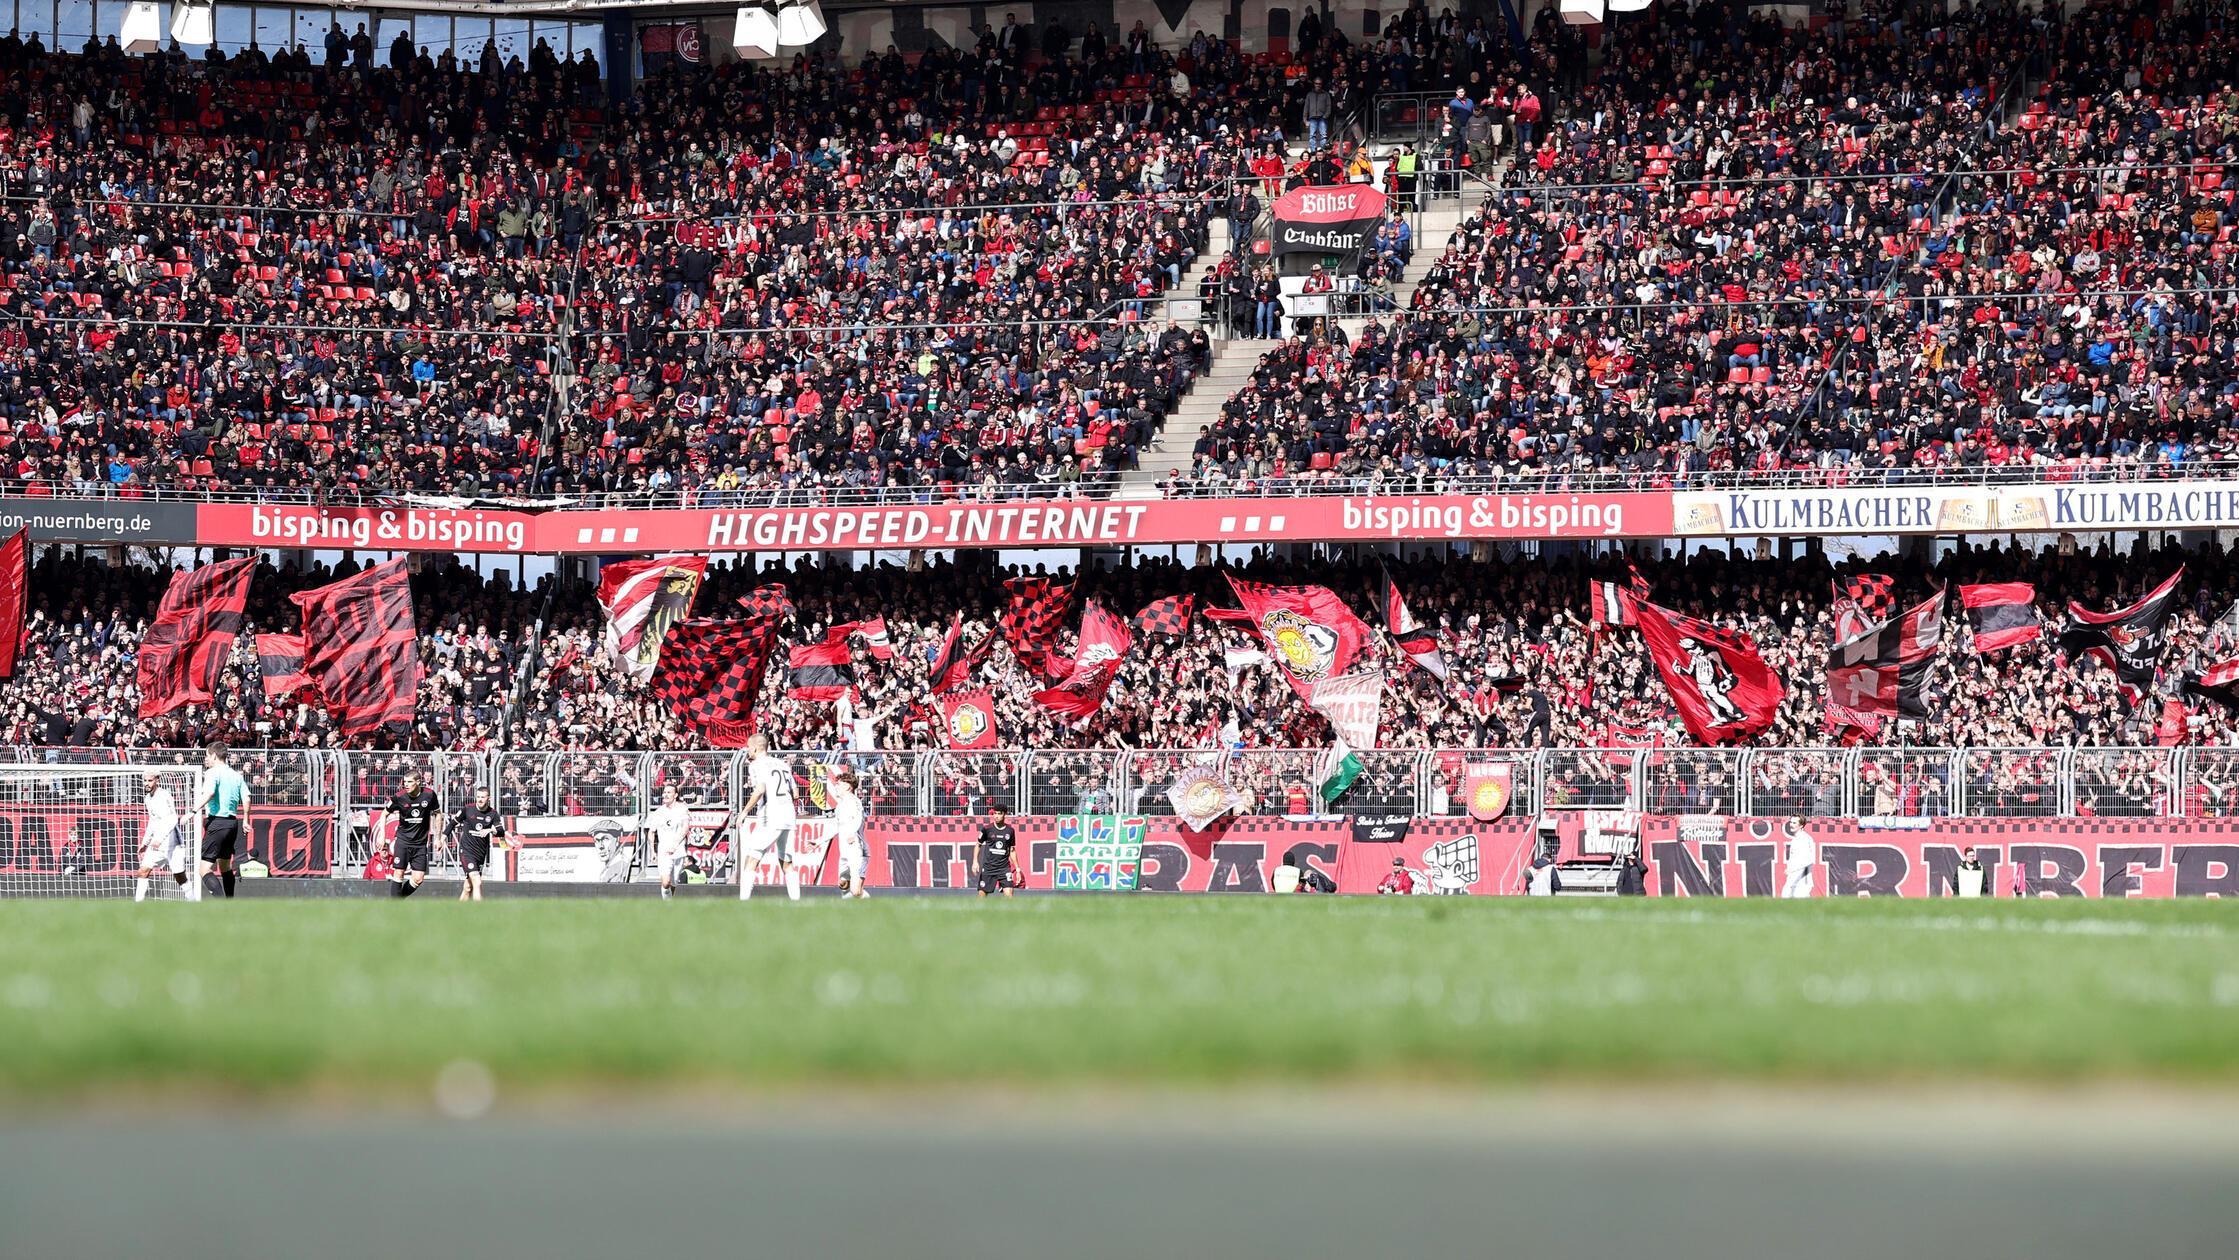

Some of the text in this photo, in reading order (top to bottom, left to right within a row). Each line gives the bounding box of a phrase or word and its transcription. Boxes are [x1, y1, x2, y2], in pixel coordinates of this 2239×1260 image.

[1300, 193, 1357, 215] Böhse
[0, 509, 152, 533] ion-nuernberg.de
[252, 506, 525, 550] bisping & bisping
[707, 504, 1147, 547] HIGHSPEED-INTERNET
[1343, 497, 1622, 537] bisping & bisping
[1728, 493, 1933, 530] KULMBACHER
